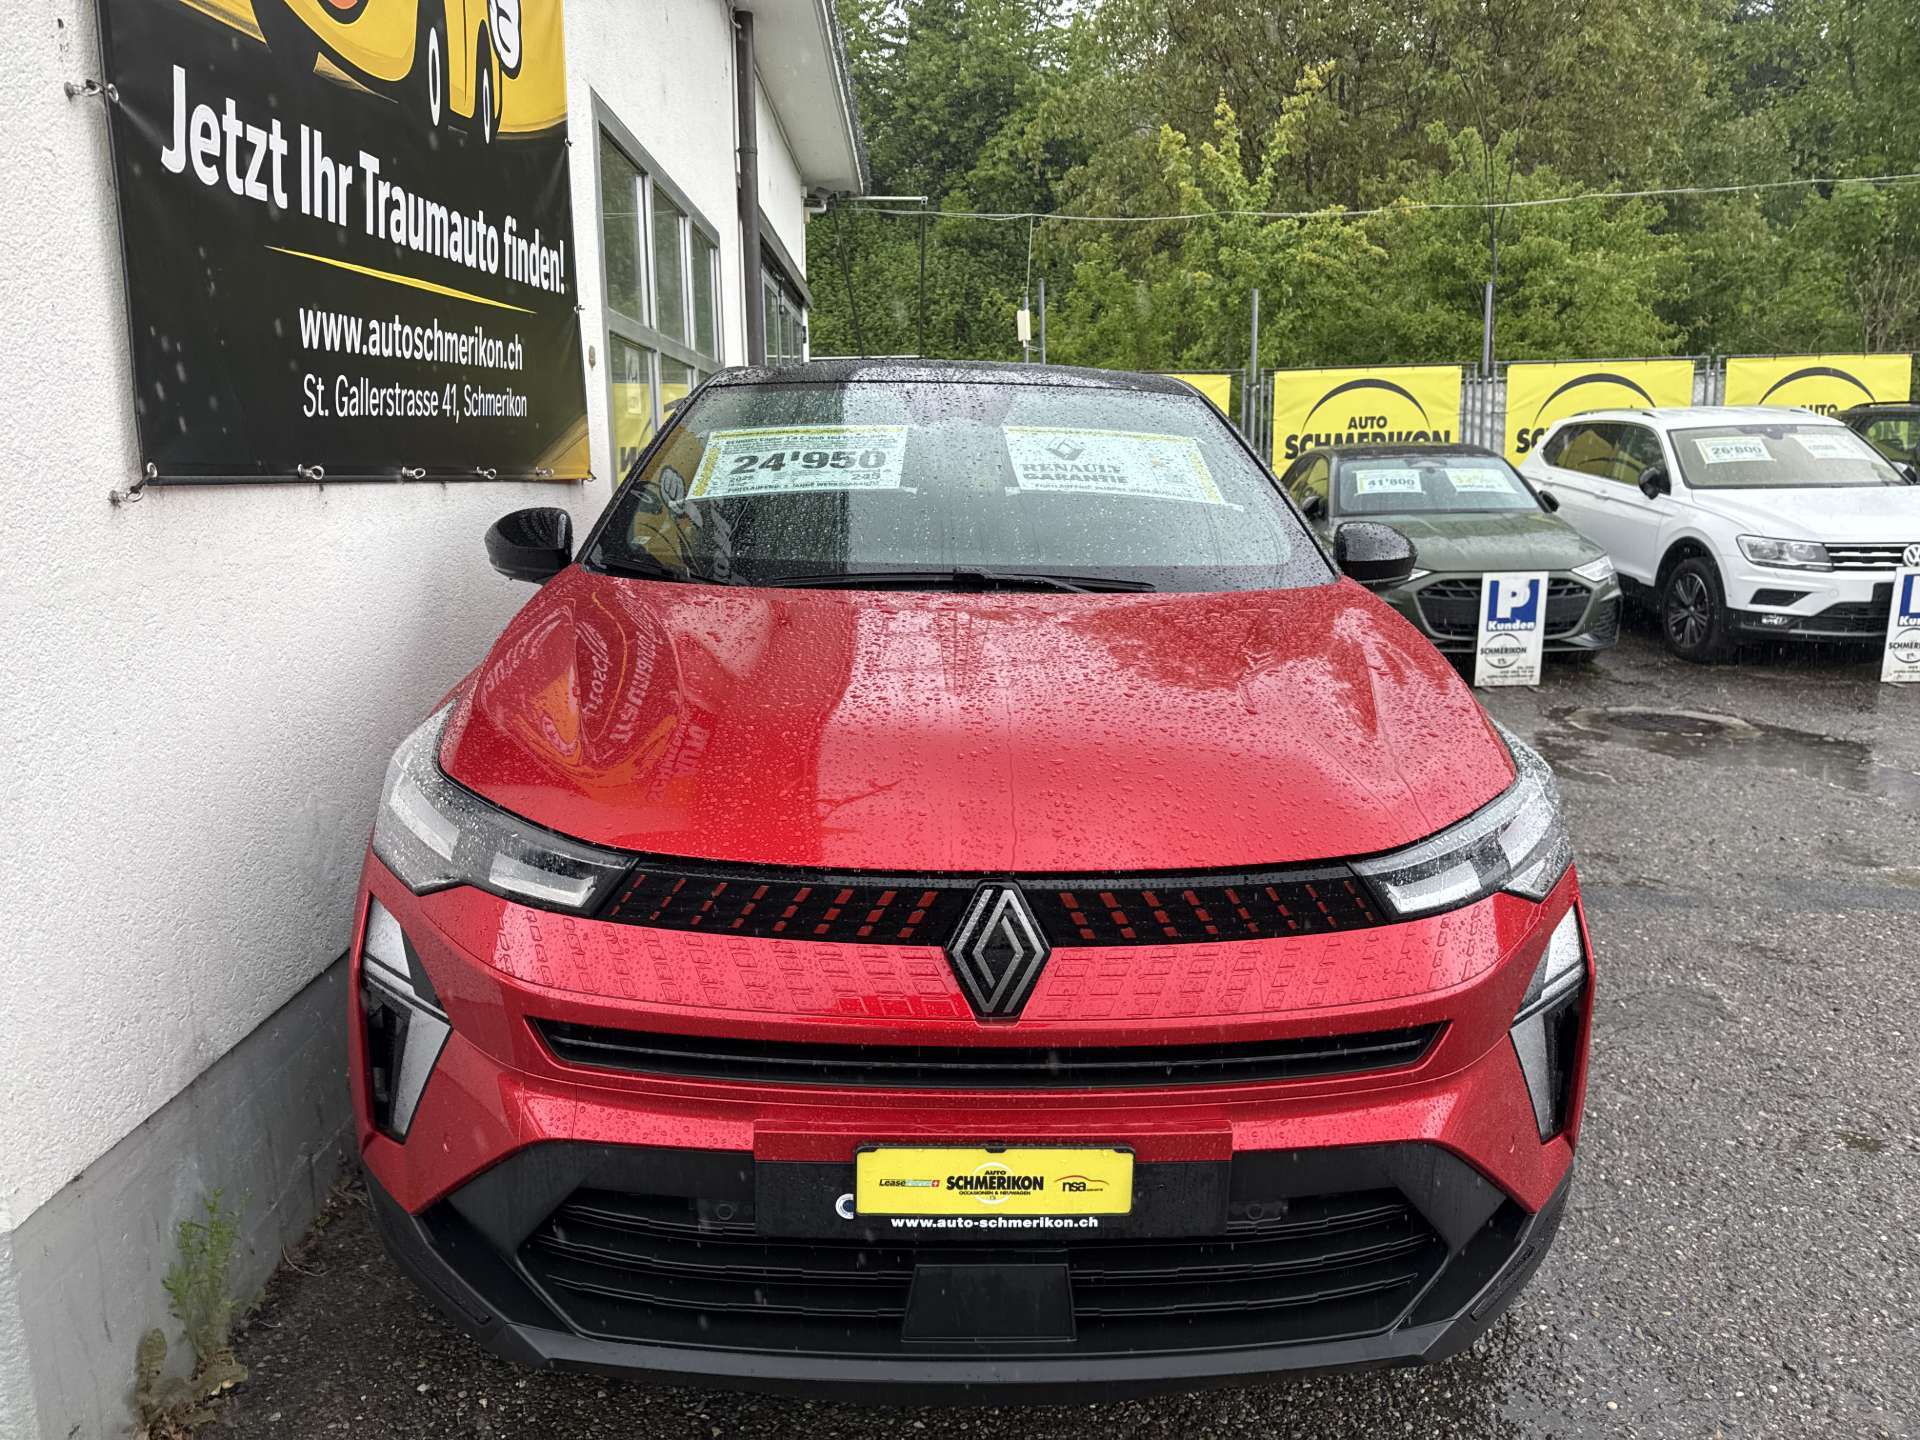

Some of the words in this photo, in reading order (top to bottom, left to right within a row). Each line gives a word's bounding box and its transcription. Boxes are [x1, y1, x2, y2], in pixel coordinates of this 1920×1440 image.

[161, 64, 288, 210] Jetzt
[300, 124, 353, 228] Ihr
[359, 150, 499, 275] Traumauto
[503, 215, 566, 294] finden!
[299, 308, 523, 371] www.autoschmerikon.ch
[303, 374, 329, 418] St.
[334, 374, 439, 418] Gallerstrasse
[442, 388, 460, 423] 41,
[463, 389, 528, 418] Schmerikon
[1348, 416, 1388, 430] AUTO
[728, 449, 886, 475] 24'950
[1021, 463, 1121, 474] RENAULT
[1023, 473, 1129, 484] GARANTIE
[1487, 619, 1536, 631] Kunden
[1480, 646, 1527, 655] SCHMERIKON
[946, 1175, 1044, 1190] SCHMERIKON
[1062, 1181, 1087, 1192] nsa
[891, 1217, 1099, 1228] www.auto-schmerikon.ch
